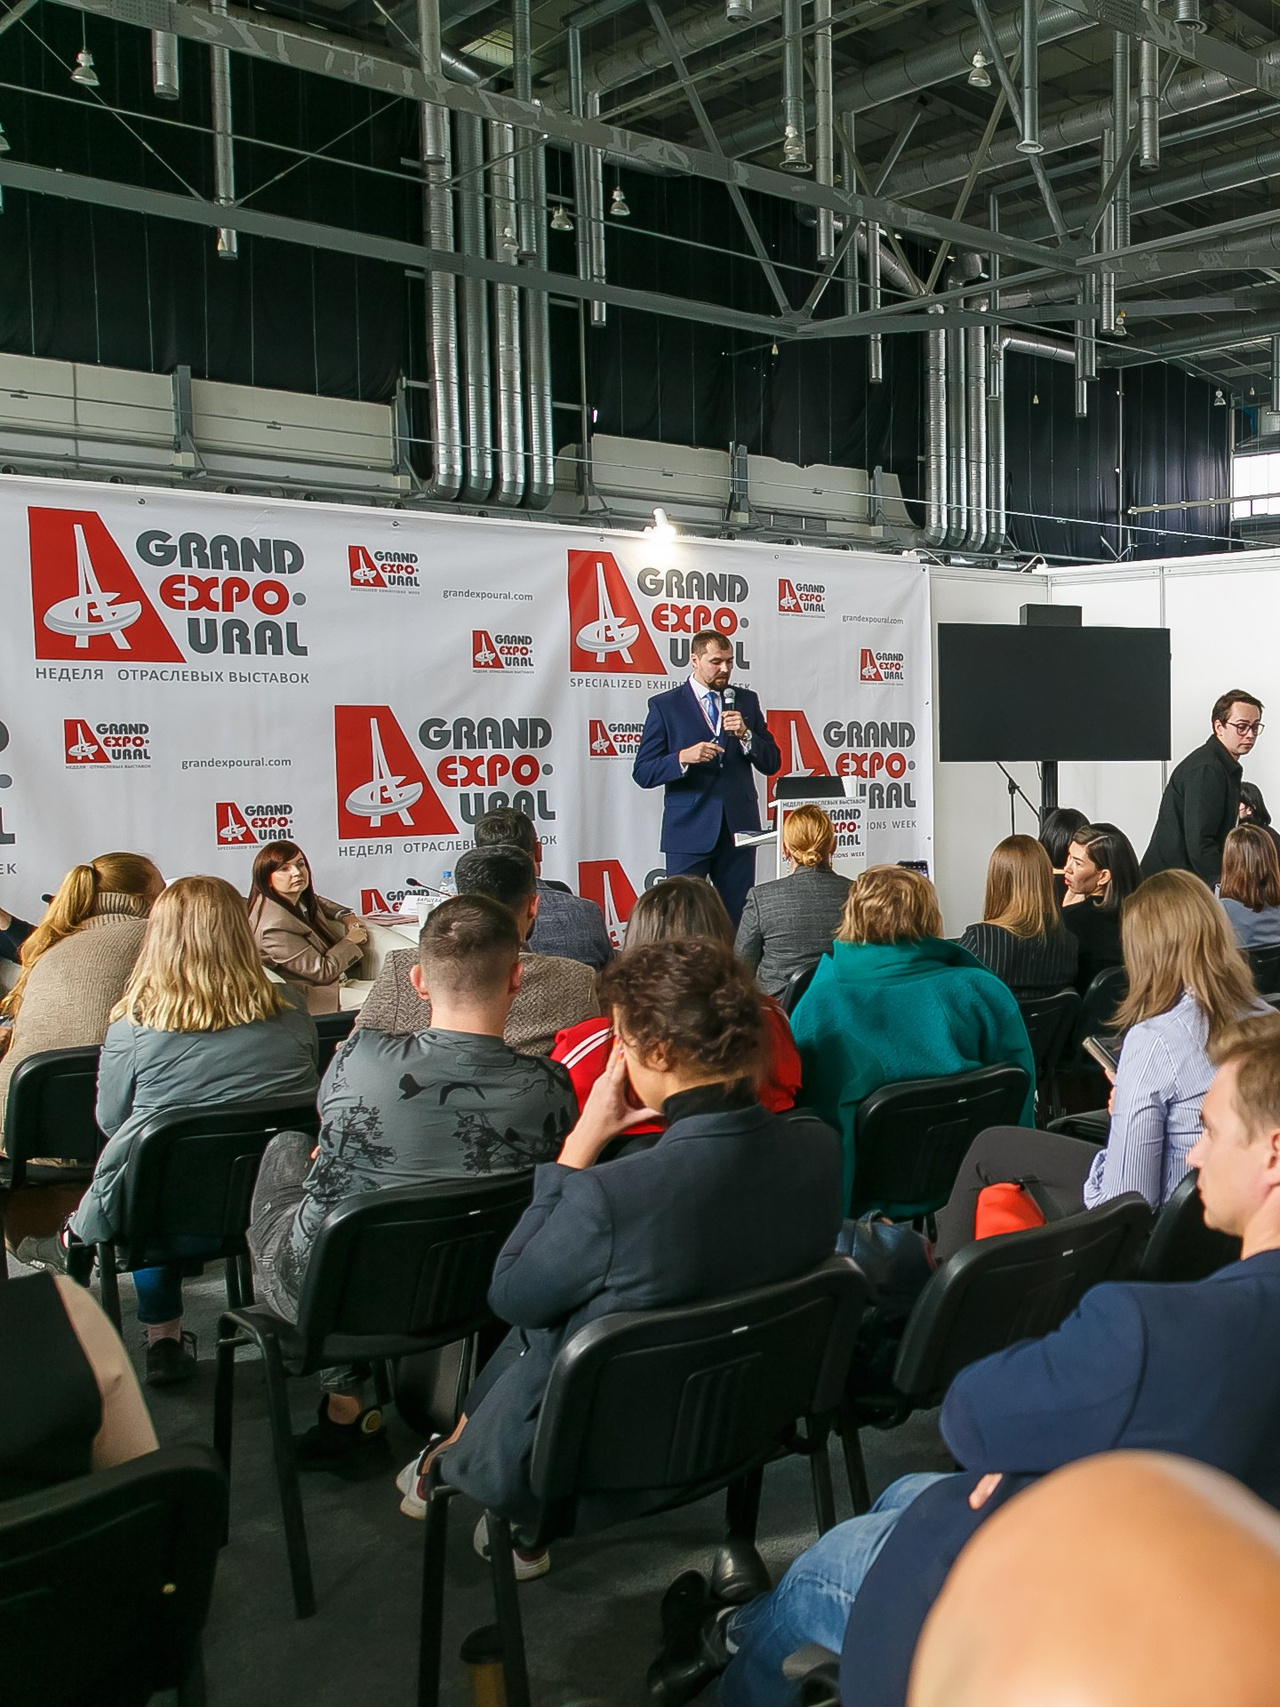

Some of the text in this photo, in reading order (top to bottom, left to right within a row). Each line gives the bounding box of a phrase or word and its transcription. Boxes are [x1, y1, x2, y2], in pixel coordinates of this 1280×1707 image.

[136, 529, 305, 574] GRAND
[373, 550, 418, 564] GRAND
[388, 575, 420, 587] URAL
[637, 567, 749, 603] GRAND
[443, 588, 533, 601] grandexpoural.com
[795, 583, 826, 593] GRAND
[159, 574, 289, 616] EXPO
[803, 602, 825, 612] URAL
[842, 614, 904, 625] grandexpoural.com
[187, 617, 308, 657] URAL
[495, 634, 533, 645] GRAND
[669, 638, 750, 670] UL
[875, 652, 904, 662] GRAND
[504, 656, 534, 667] URAL
[35, 667, 310, 684] НЕДЕЛЯ ОТРАСЛЕВЫХ ВЫСТАВОК
[884, 671, 904, 680] URAL
[570, 678, 686, 690] SPECIALIZED EXHIBI
[96, 723, 150, 735] GRAND
[418, 717, 552, 750] GRAND
[823, 721, 916, 748] GRAND
[111, 748, 151, 760] URAL
[619, 744, 640, 753] URA
[181, 757, 292, 770] grandexpoural.com
[244, 804, 293, 817] GRAND
[825, 808, 862, 821] RAND
[833, 821, 857, 834] XPO
[892, 820, 917, 829] WEEK
[258, 828, 294, 841] URAL
[339, 840, 477, 858] НЕДЕЛЯ ОТРАСЛЕВ
